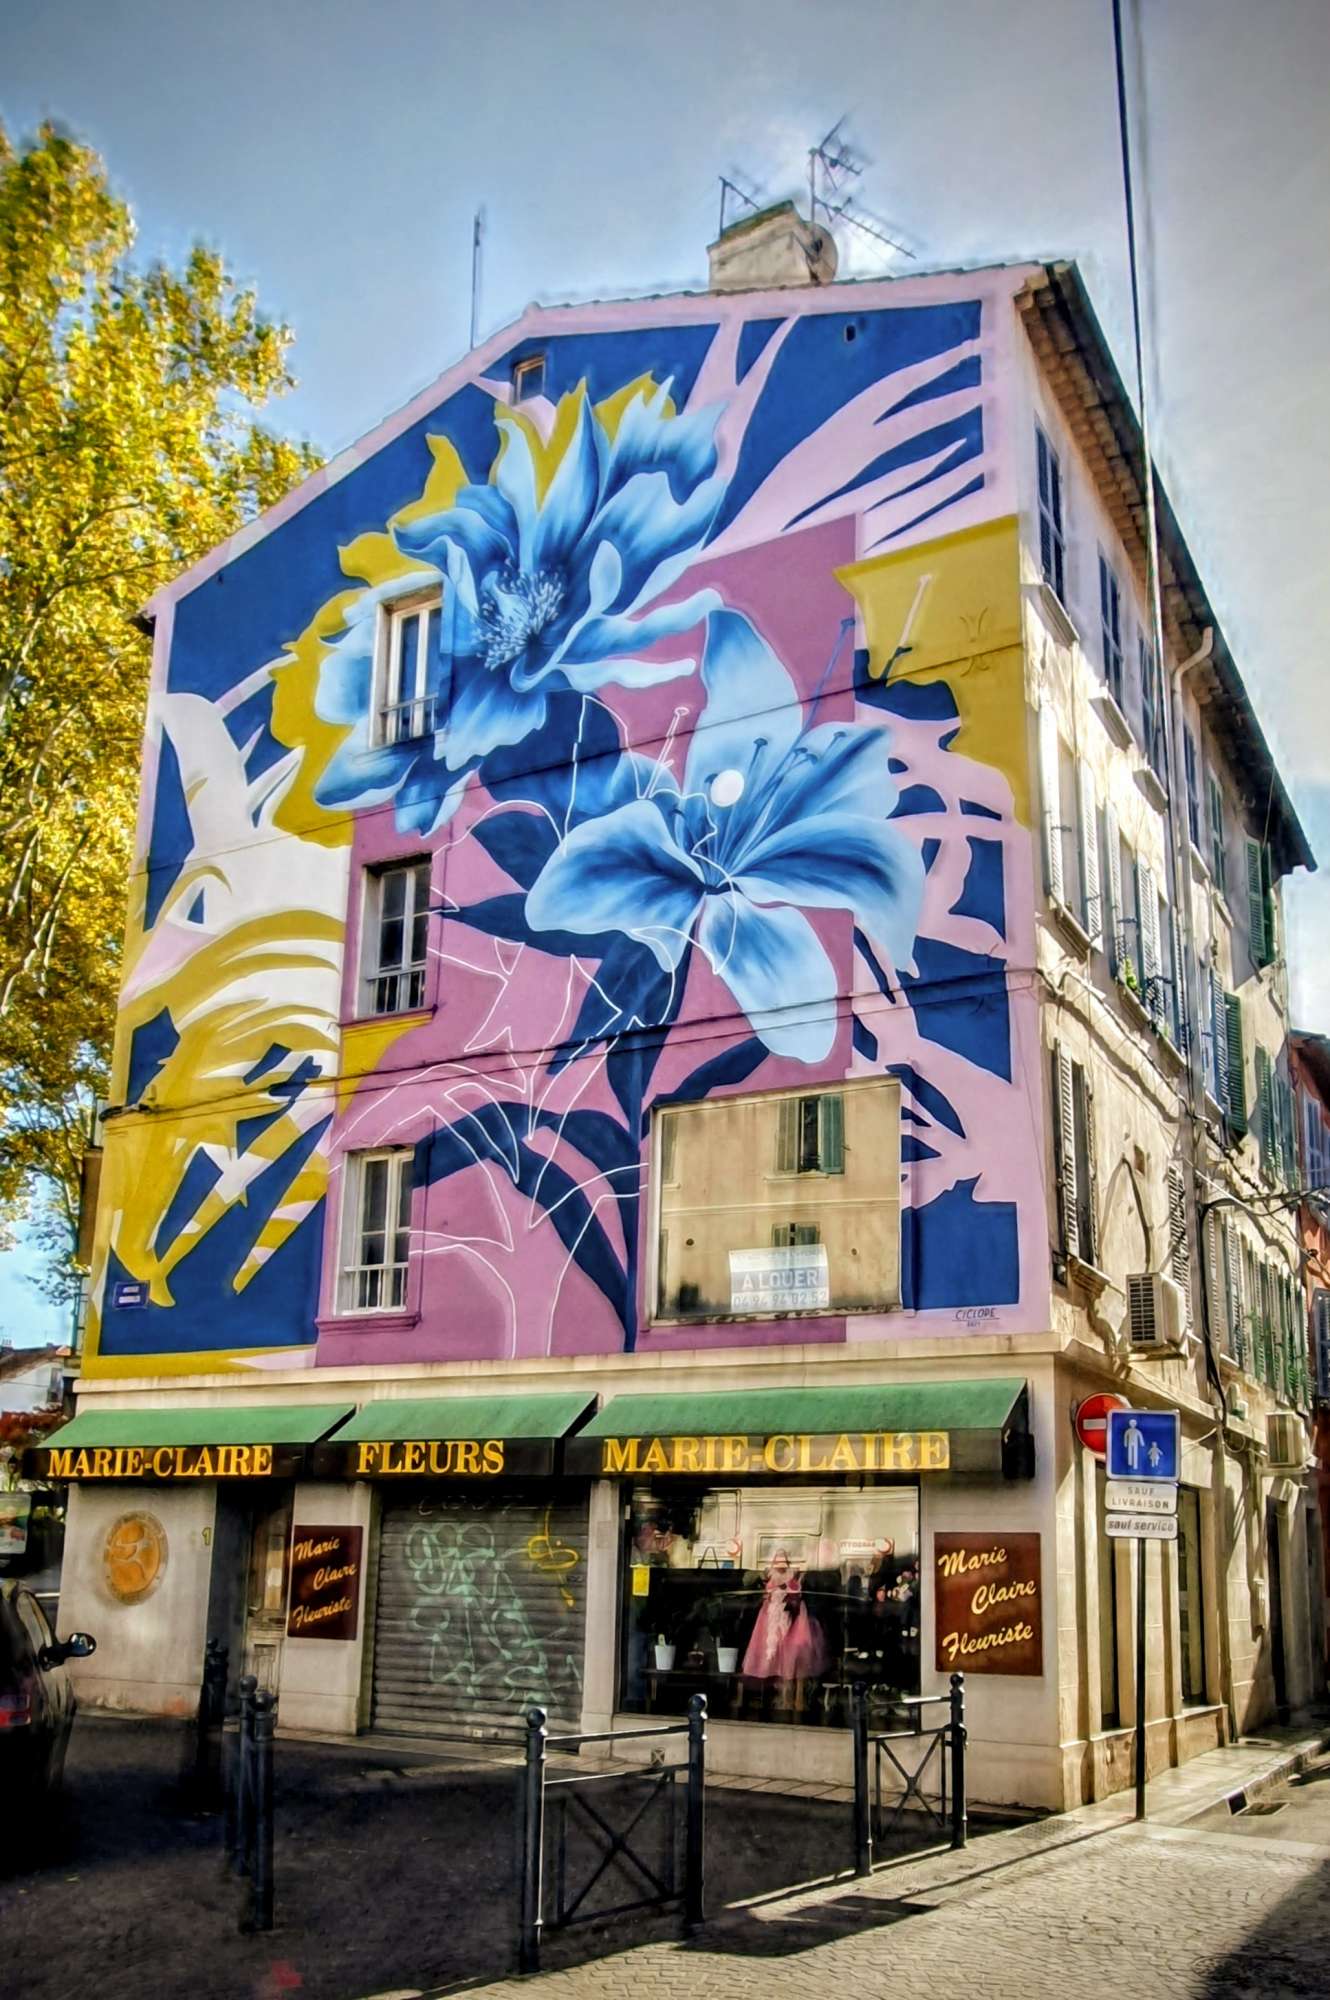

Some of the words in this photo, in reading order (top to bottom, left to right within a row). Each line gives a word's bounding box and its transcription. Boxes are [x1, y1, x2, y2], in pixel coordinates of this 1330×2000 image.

[742, 1272, 754, 1290] A
[758, 1269, 818, 1289] LOUER
[47, 1445, 273, 1477] MARIE-CLAIRE
[356, 1440, 505, 1474] FLEURS
[602, 1432, 949, 1473] MARIE-CLAIRE
[1111, 1496, 1170, 1509] LIVRAISON
[1127, 1486, 1155, 1496] SAUF
[1133, 1520, 1174, 1532] service
[295, 1536, 340, 1560] Marie
[938, 1546, 1007, 1577] Marie
[313, 1565, 357, 1591] Claire
[293, 1596, 352, 1628] Fleuriste
[971, 1580, 1036, 1615] Claire
[942, 1621, 1033, 1661] Fleuriste
